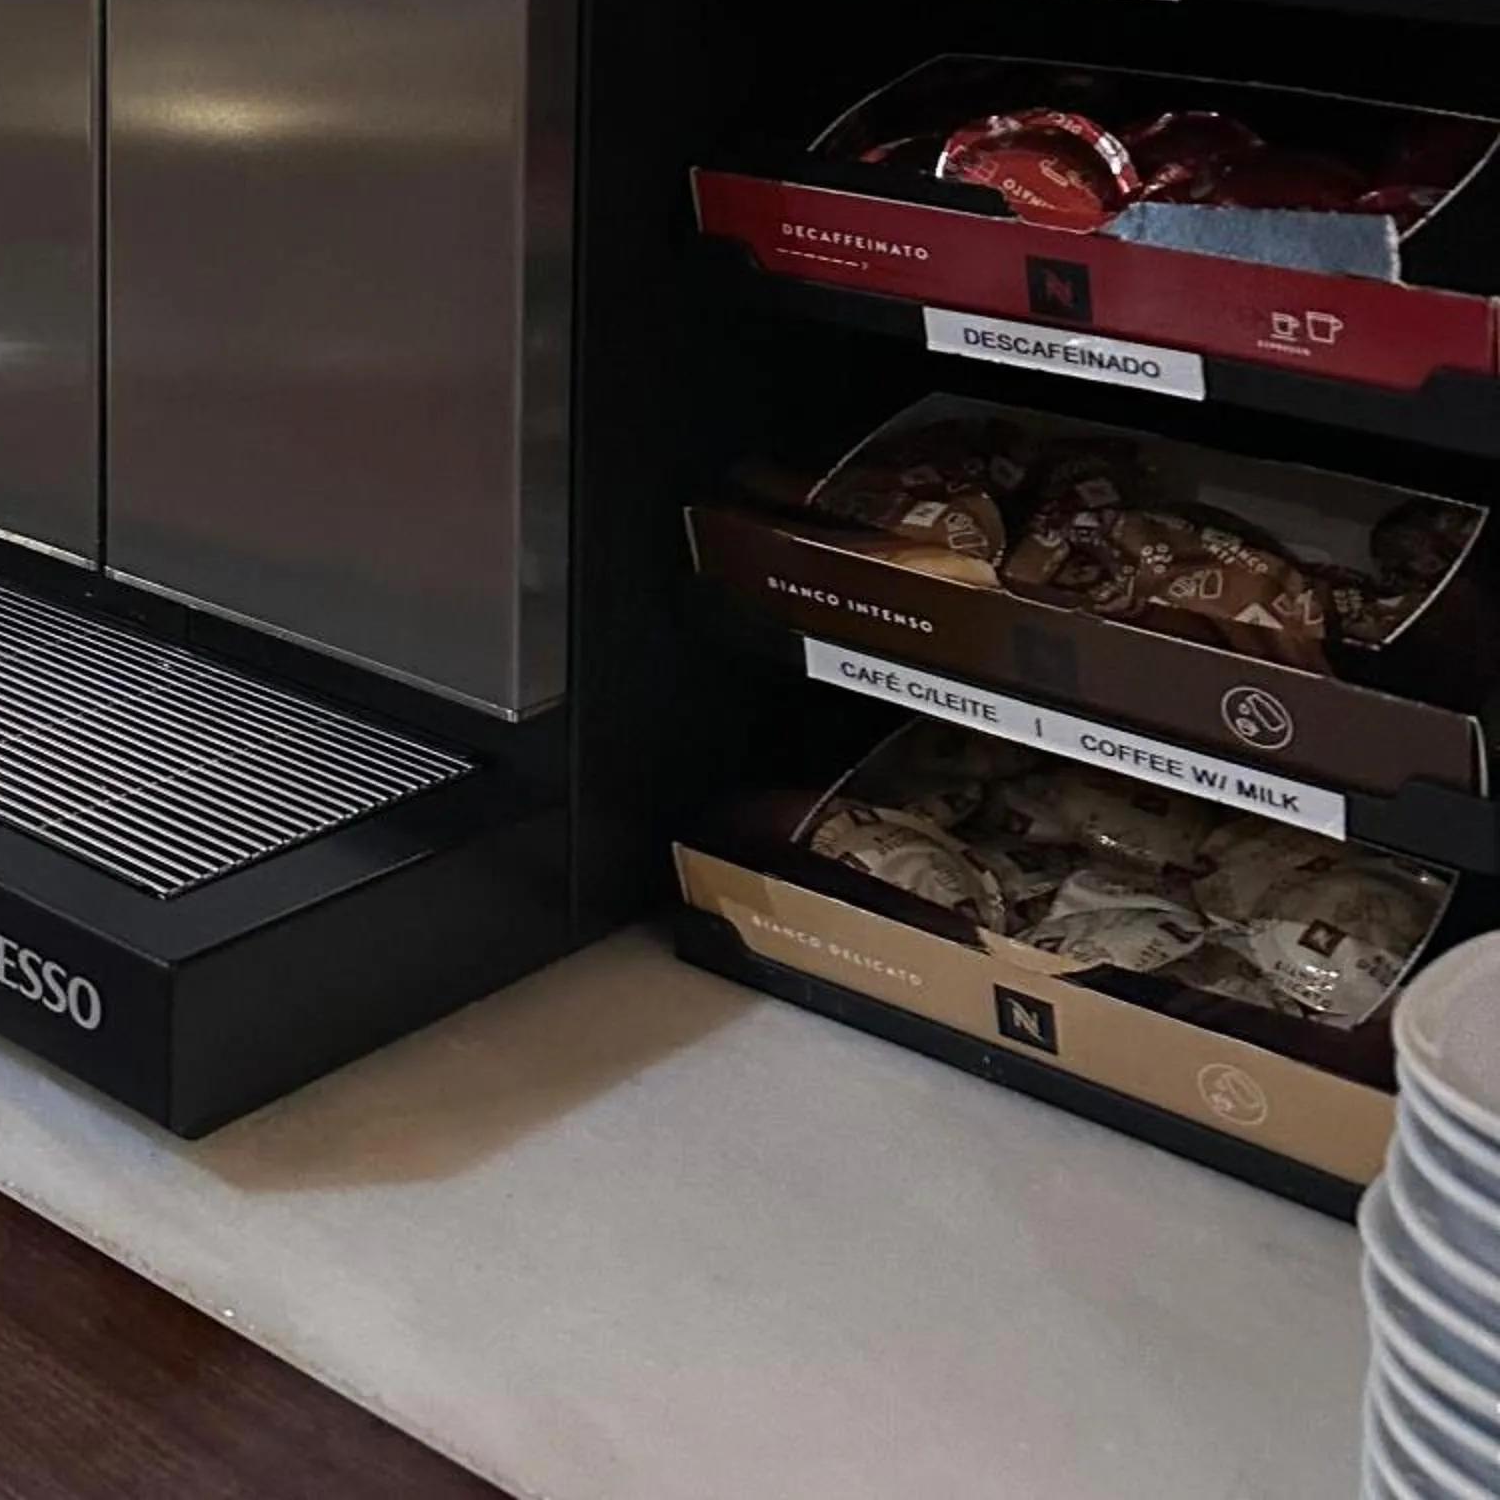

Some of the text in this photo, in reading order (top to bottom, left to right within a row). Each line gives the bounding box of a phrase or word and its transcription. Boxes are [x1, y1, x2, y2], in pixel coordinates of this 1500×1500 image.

[781, 222, 931, 262] DECAFFEINATO
[961, 325, 1163, 382] DESCAFEINADO
[766, 575, 934, 634] BIANCO INTENSO
[839, 660, 906, 694] CAFÉ
[906, 680, 1000, 724] C/LEITE
[1079, 732, 1186, 780] COFFEE
[1191, 764, 1229, 793] W/
[1235, 779, 1301, 814] MILK
[751, 913, 924, 987] BIANCO DELICATO
